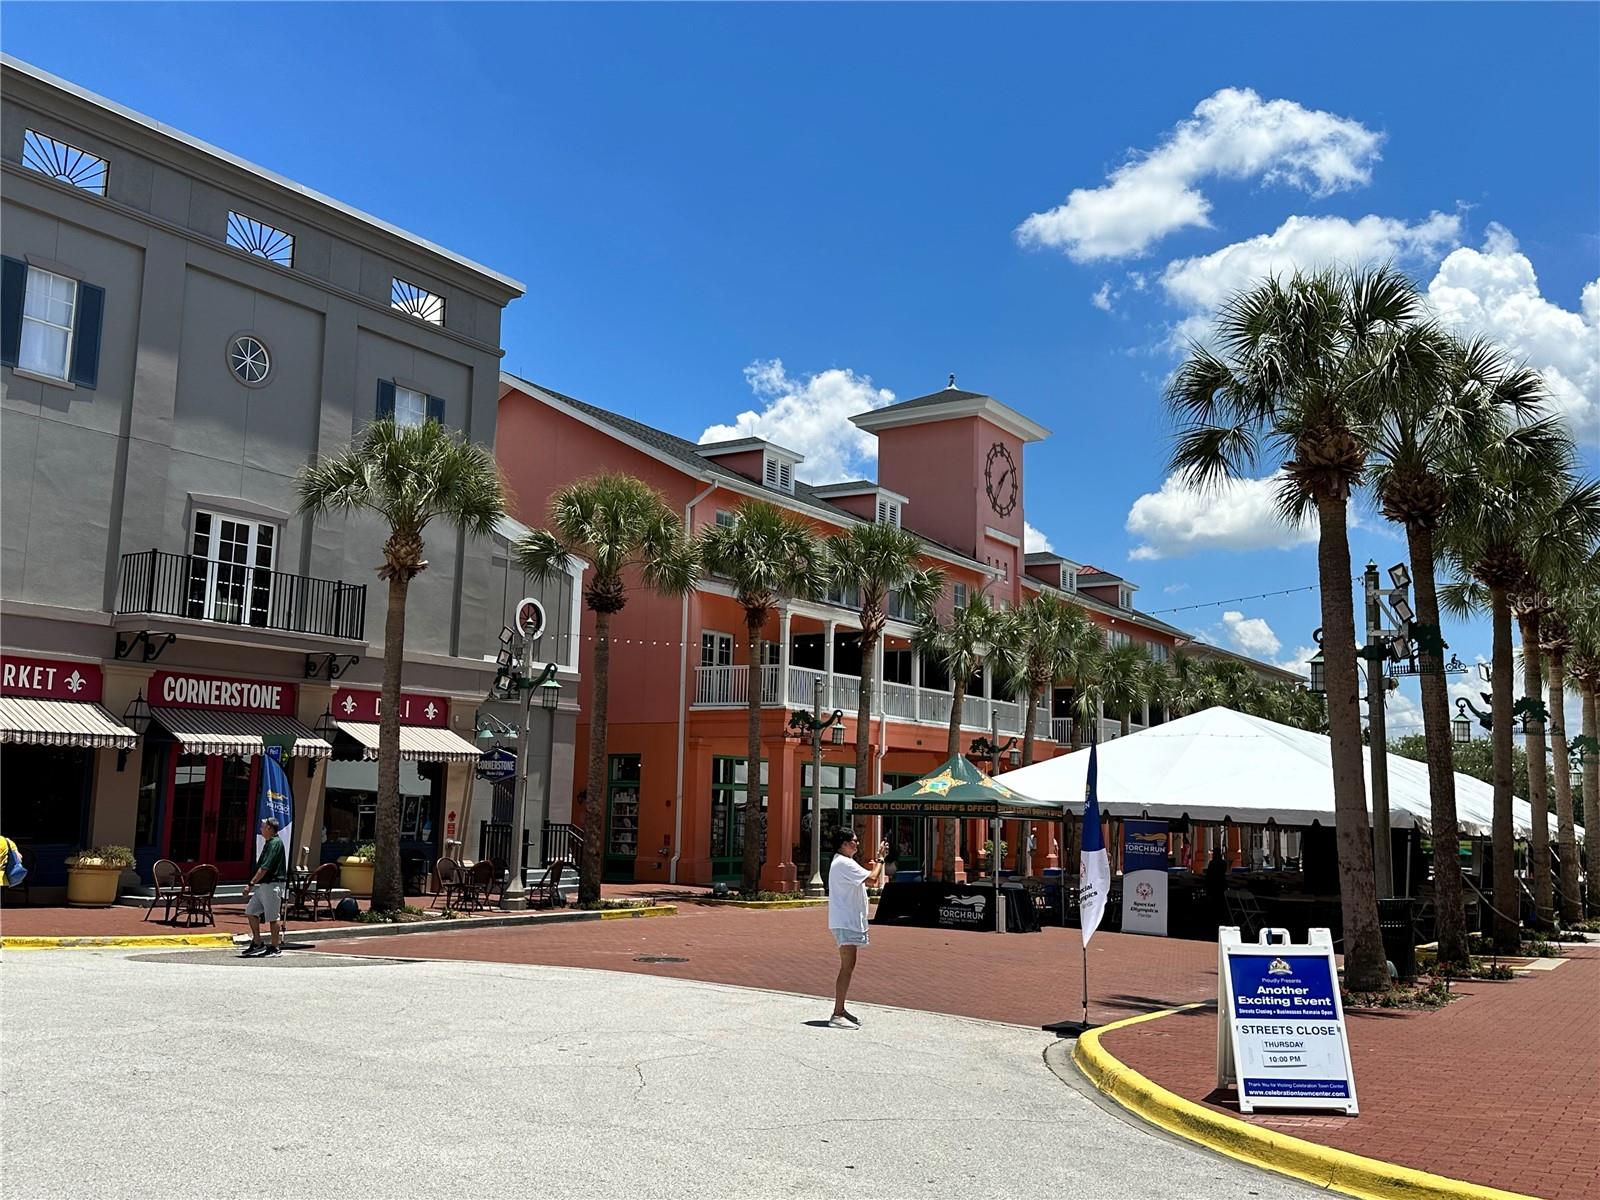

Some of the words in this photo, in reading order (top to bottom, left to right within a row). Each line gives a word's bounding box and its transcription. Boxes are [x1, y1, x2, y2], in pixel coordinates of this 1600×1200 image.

[3, 663, 57, 690] RKET
[163, 676, 281, 710] CORNERSTONE
[890, 803, 921, 811] COUNTY
[967, 804, 996, 812] OFFICE
[1125, 844, 1150, 852] TORCH
[939, 909, 966, 919] TORCH
[966, 911, 984, 920] RUN
[1257, 986, 1309, 995] Another
[1238, 996, 1290, 1007] Exciting
[1294, 997, 1331, 1006] Event
[1241, 1025, 1293, 1035] STREETS
[1296, 1026, 1336, 1036] CLOSE
[1249, 1089, 1346, 1097] www.celebrationtowncenter.com
